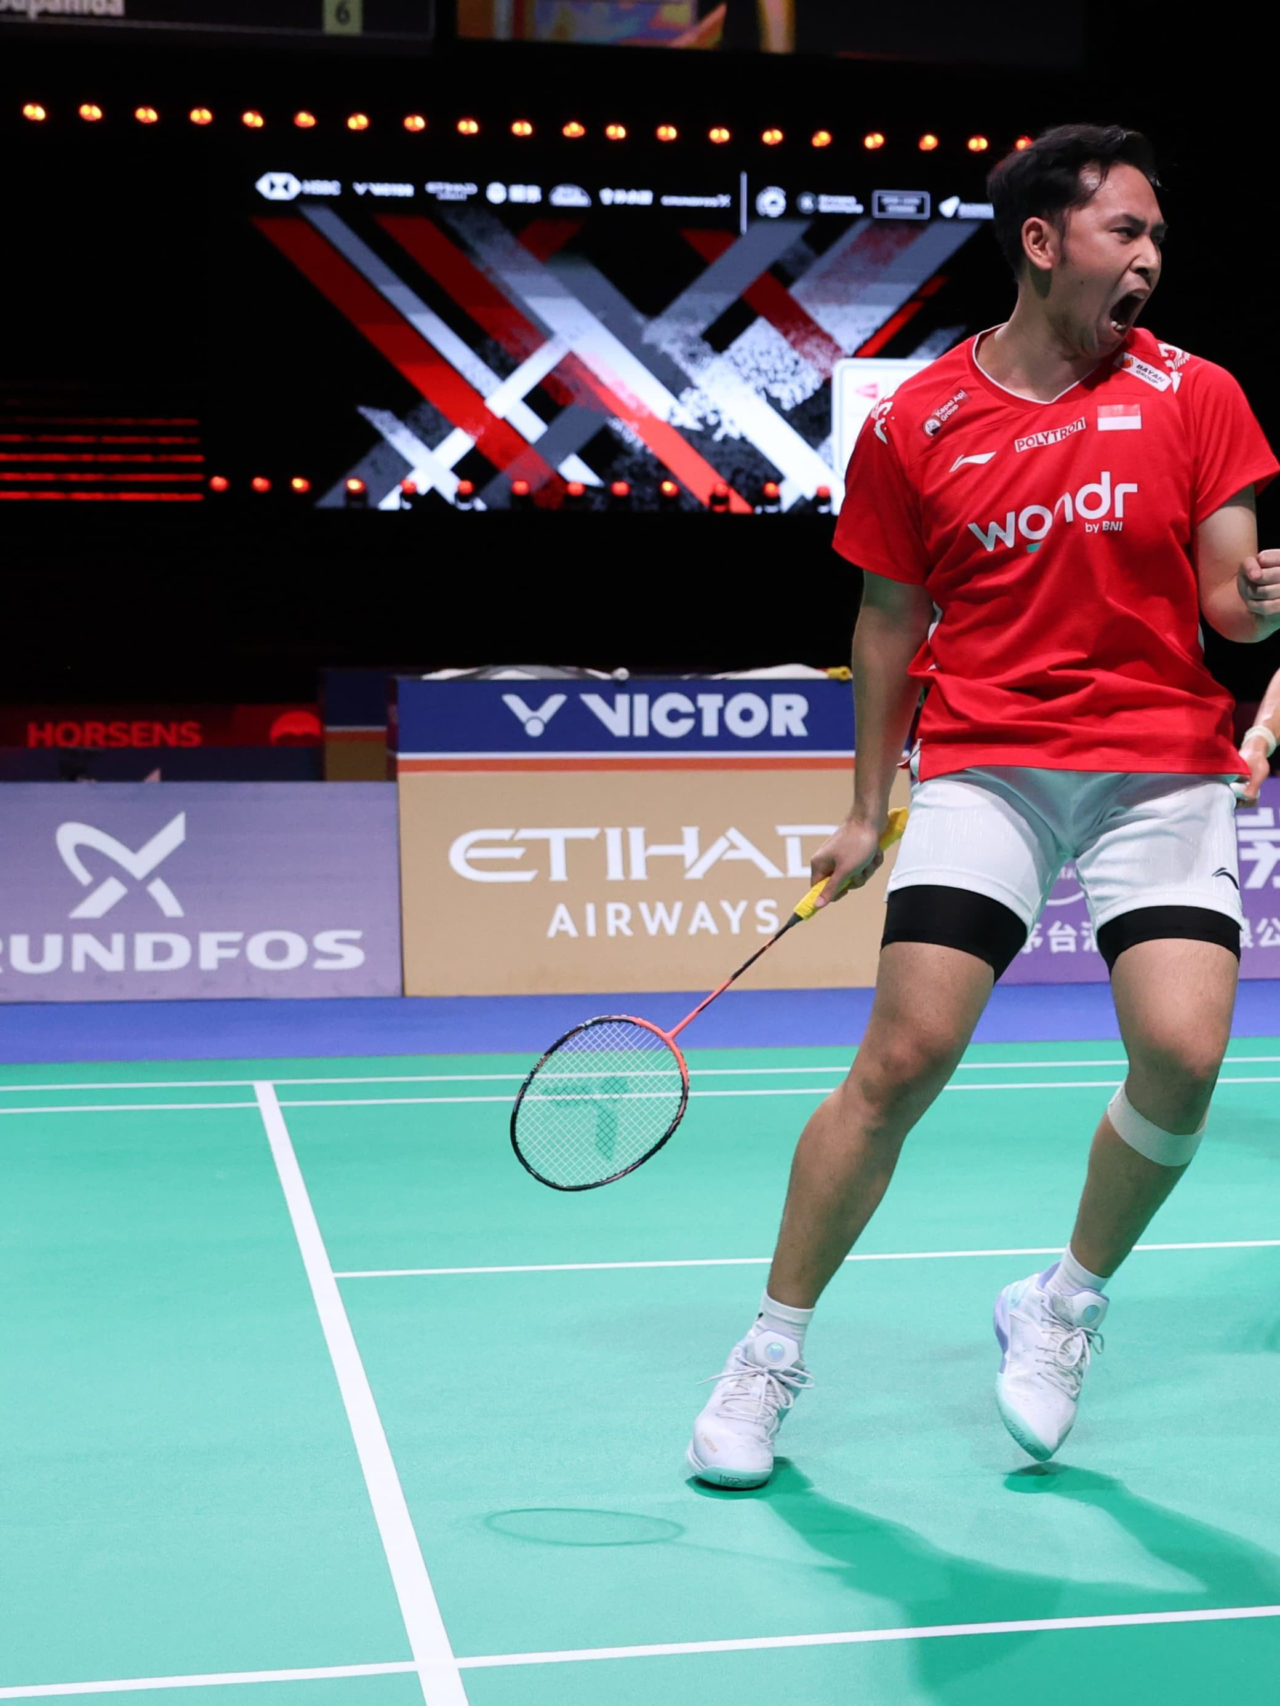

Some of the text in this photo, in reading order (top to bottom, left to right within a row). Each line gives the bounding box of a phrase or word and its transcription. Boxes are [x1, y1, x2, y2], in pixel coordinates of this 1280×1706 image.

[334, 0, 351, 26] 6
[967, 471, 1138, 552] wondr
[1085, 520, 1123, 533] by BNI
[27, 721, 202, 748] HORSENS
[580, 692, 810, 738] VICTOR
[546, 899, 780, 938] AIRWAYS
[0, 929, 365, 974] UNDFOS
